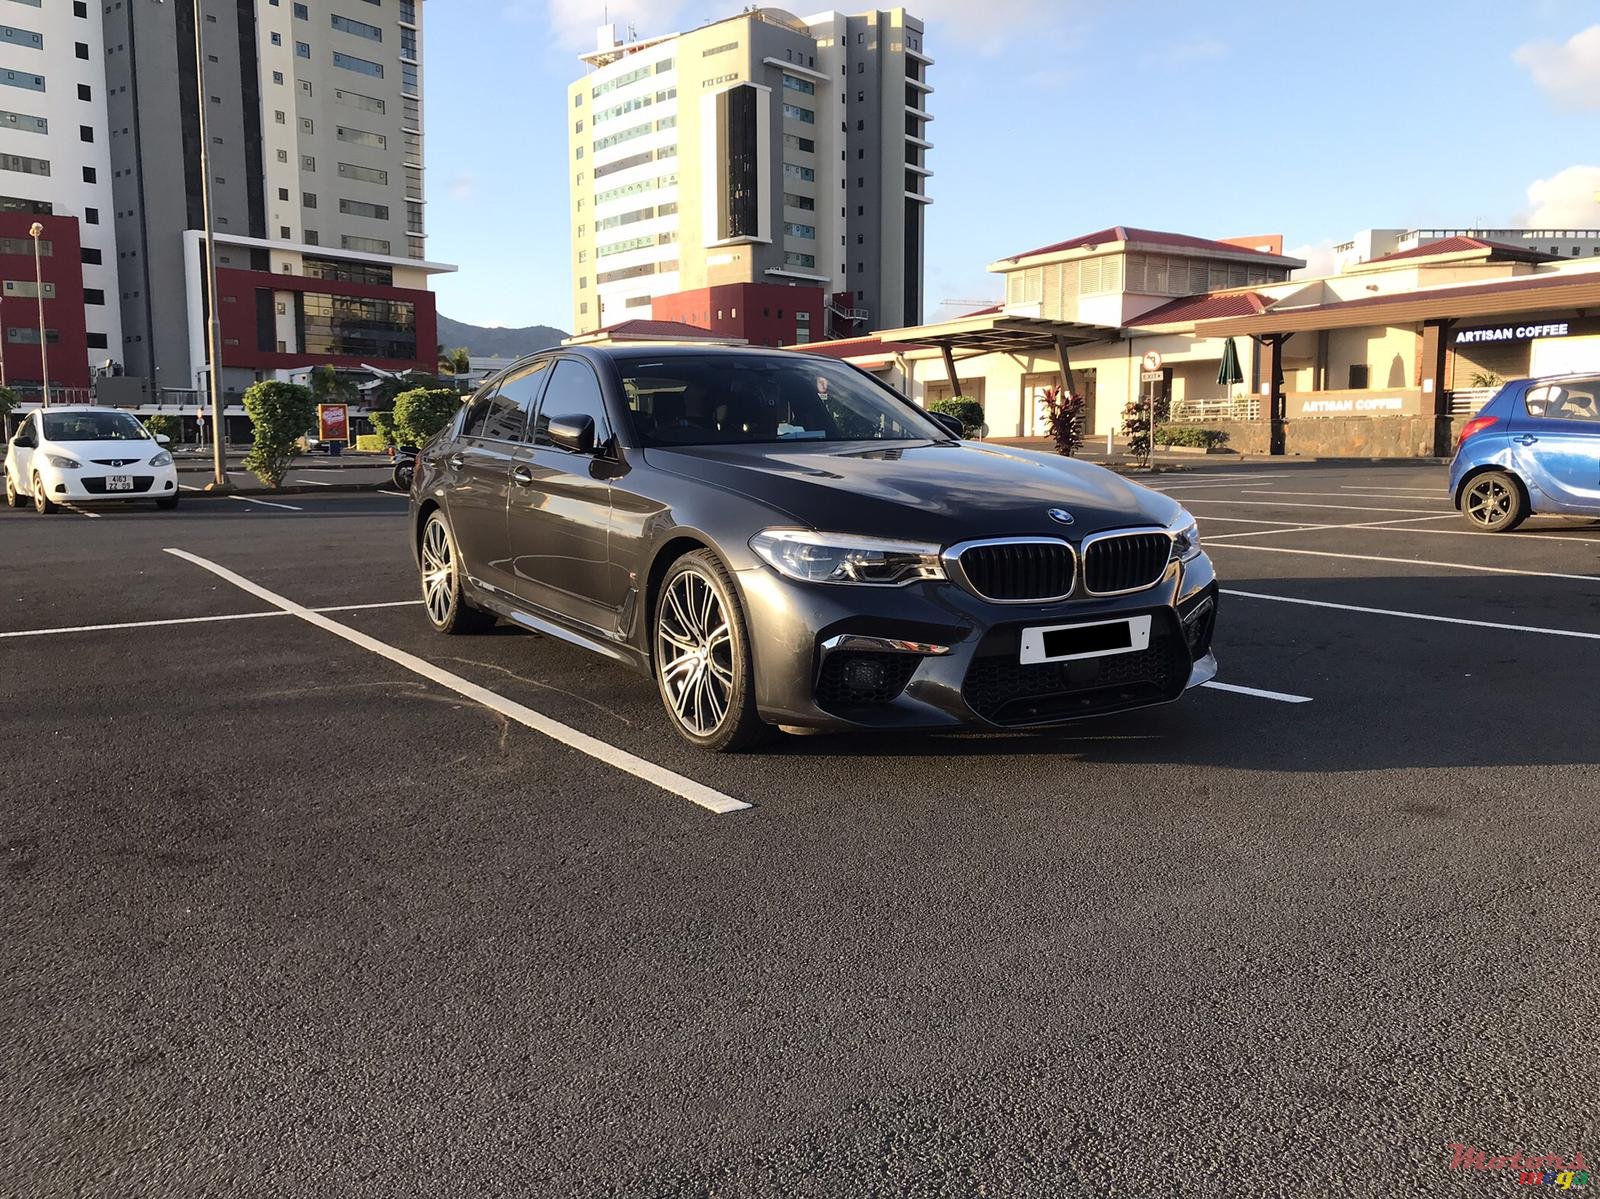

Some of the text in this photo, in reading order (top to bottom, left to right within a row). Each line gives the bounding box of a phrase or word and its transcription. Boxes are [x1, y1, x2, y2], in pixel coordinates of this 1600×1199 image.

[1456, 323, 1568, 343] ARTISAN COFFEE
[1302, 398, 1402, 413] ARTISAN COFFEE
